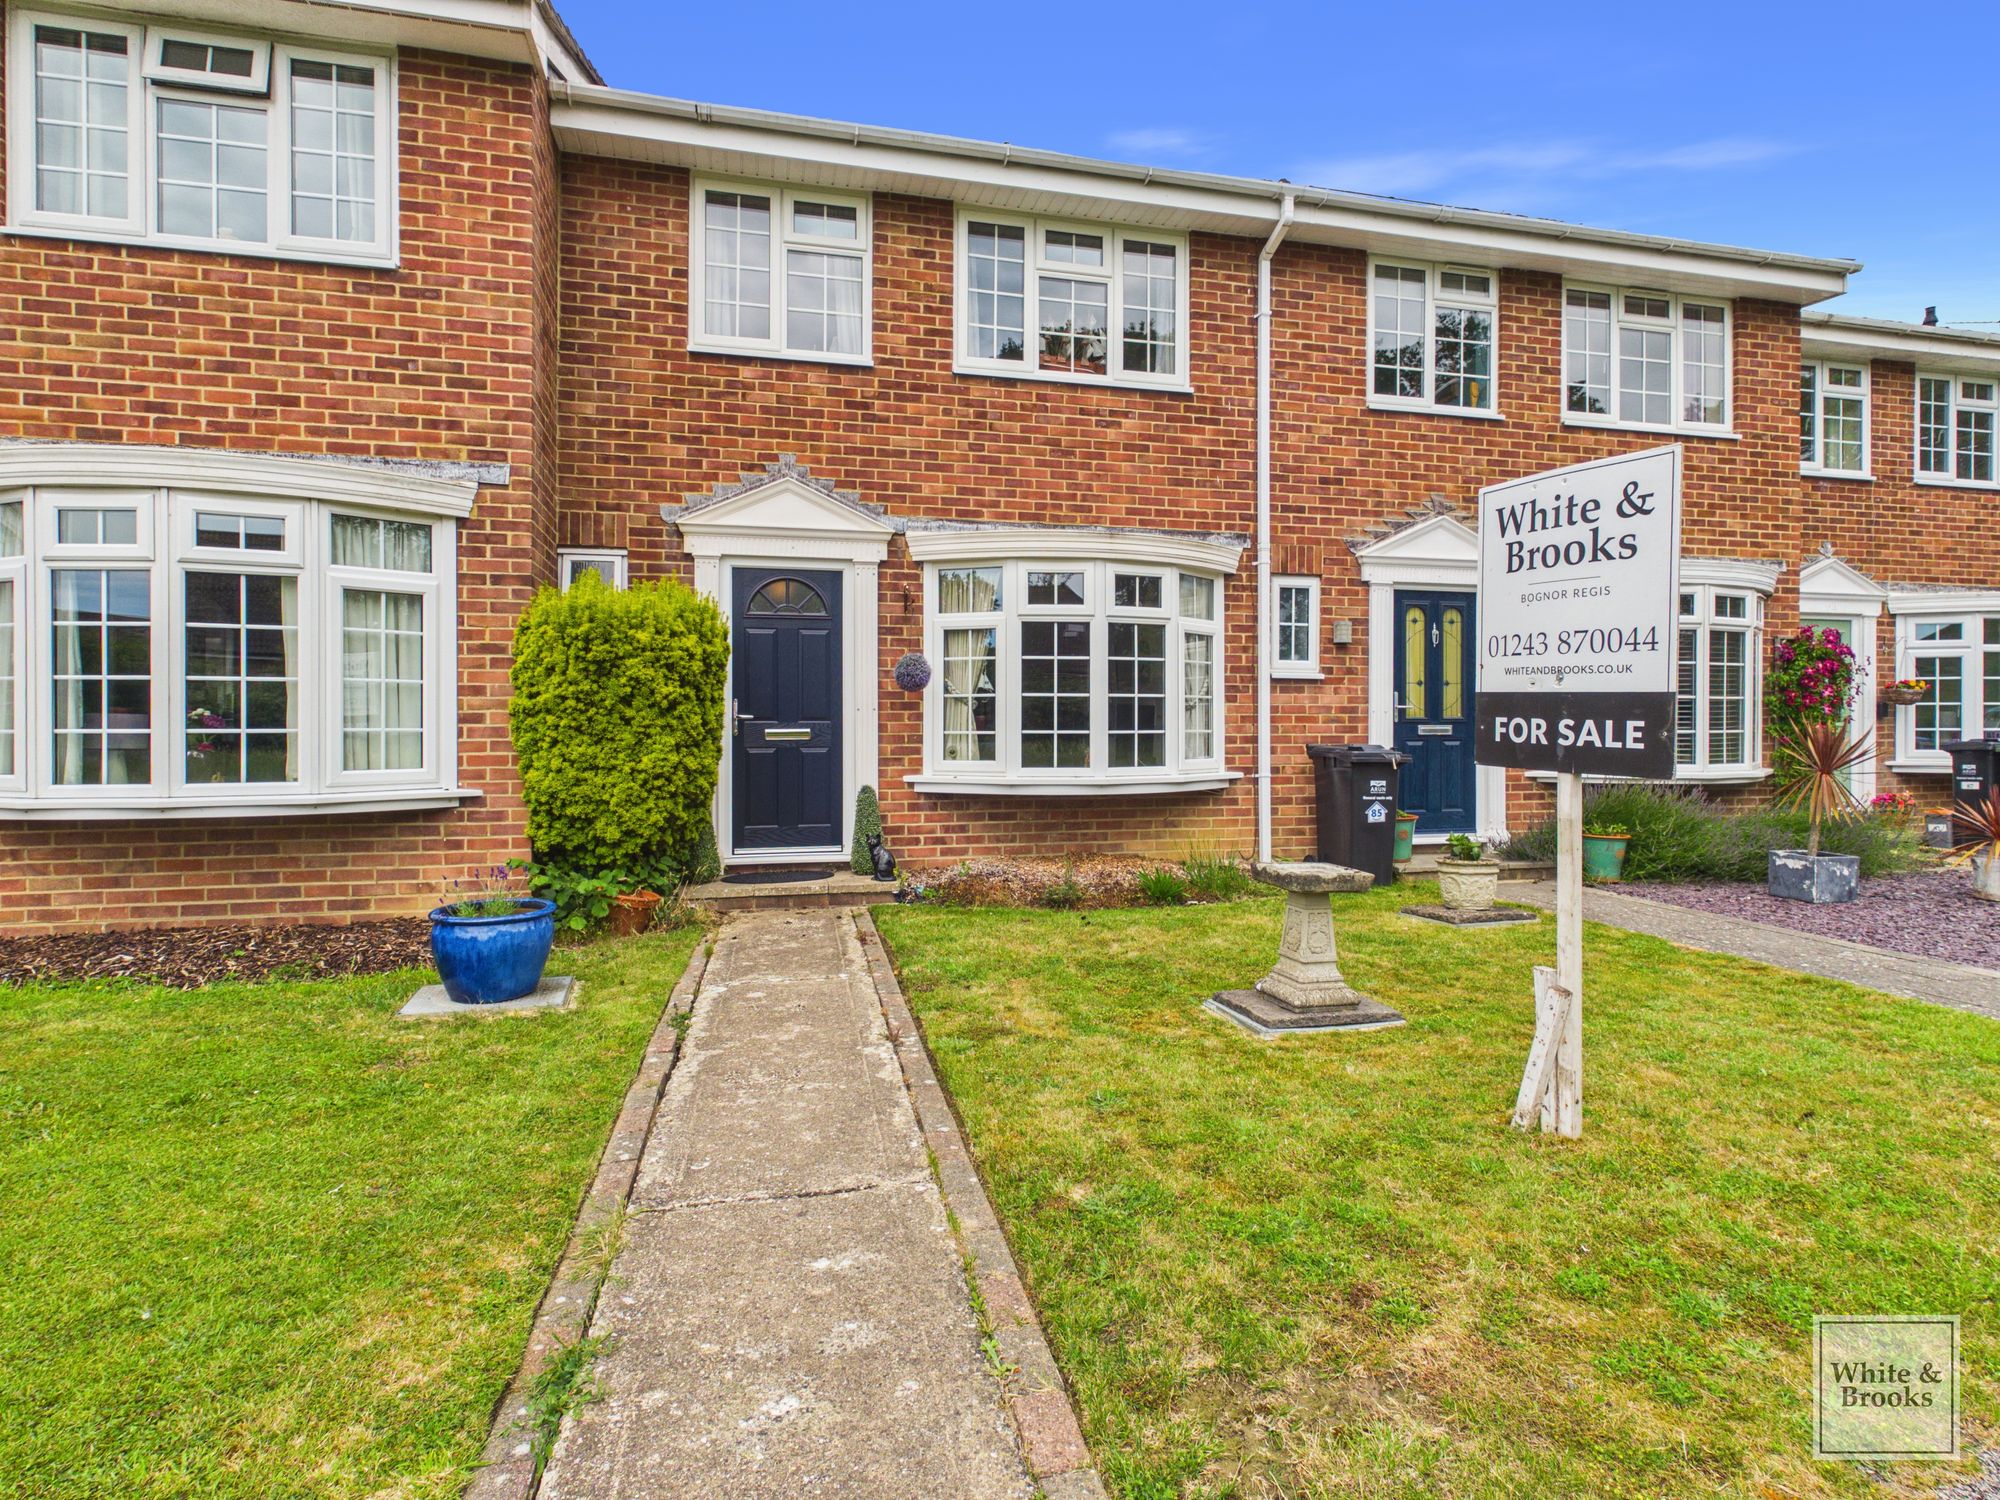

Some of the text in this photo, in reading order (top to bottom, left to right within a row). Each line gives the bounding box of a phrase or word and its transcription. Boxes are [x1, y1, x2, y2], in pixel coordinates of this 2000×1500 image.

[1495, 481, 1655, 538] White &
[1505, 527, 1637, 574] Brooks
[1520, 586, 1611, 603] BOGNOR REGIS
[1488, 626, 1659, 658] 01243 870044
[1504, 664, 1632, 676] WHITEANDBROOKS.CO.UK
[1494, 717, 1645, 749] FOR SALE
[1371, 809, 1382, 817] 85
